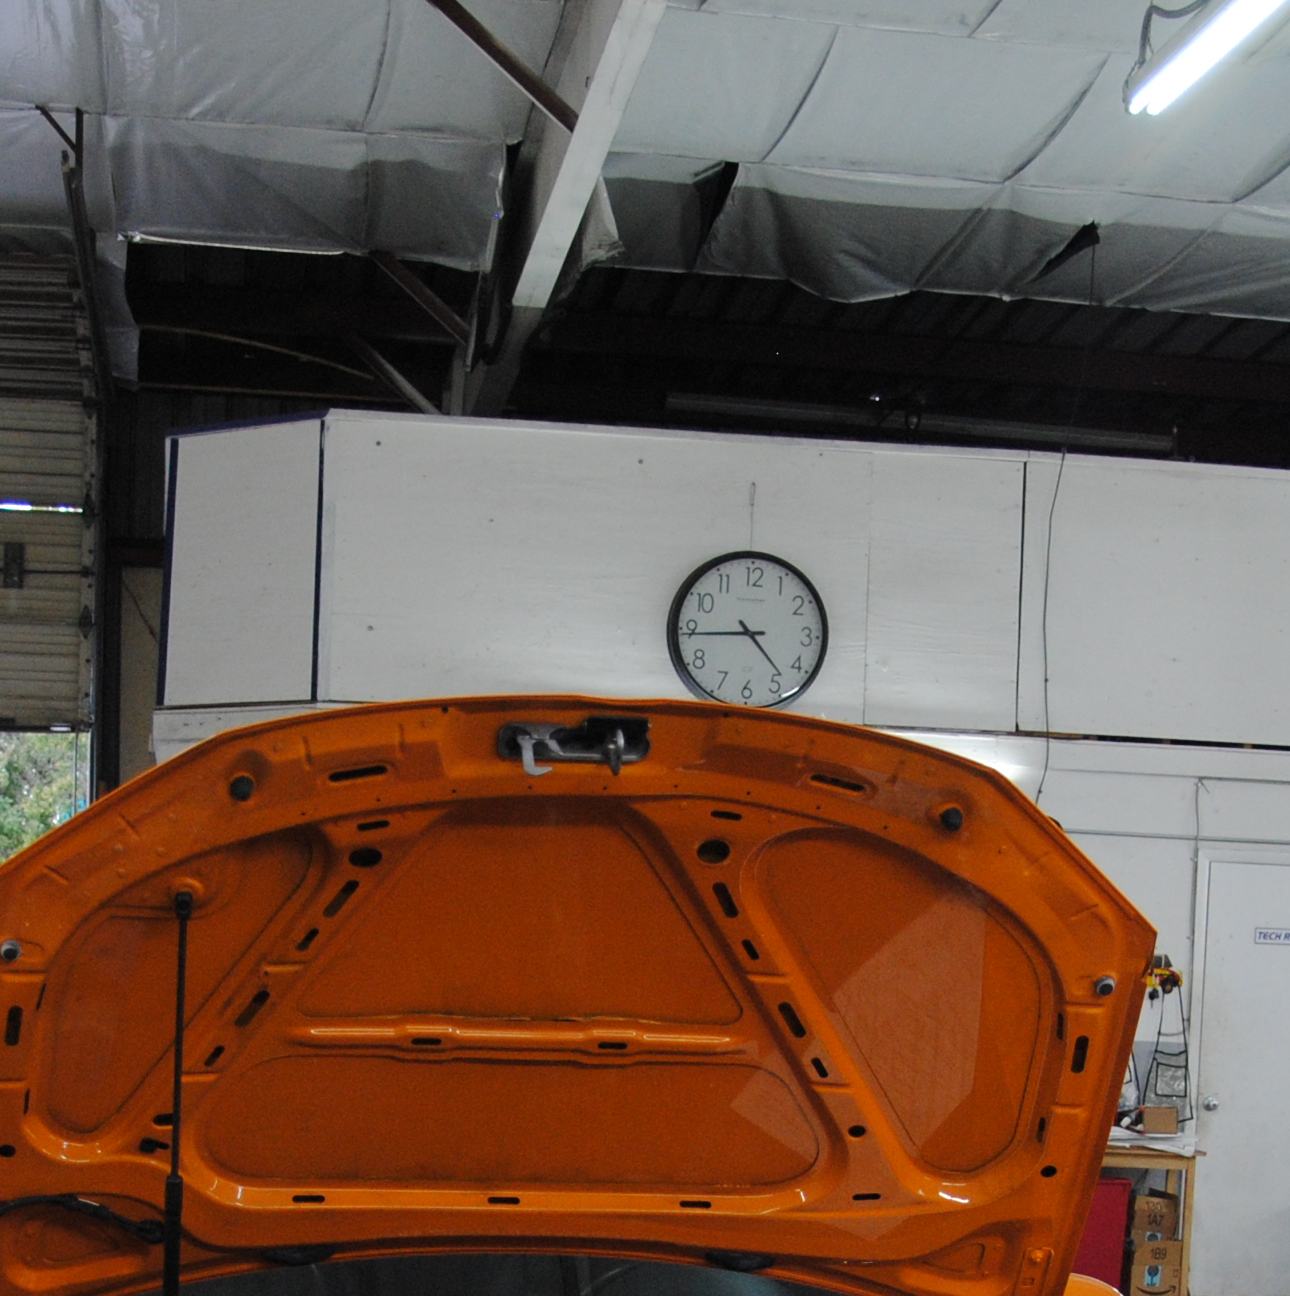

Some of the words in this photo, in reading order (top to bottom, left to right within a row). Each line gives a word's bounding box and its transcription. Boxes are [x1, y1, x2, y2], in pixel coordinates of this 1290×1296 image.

[718, 574, 731, 594] 11
[746, 566, 764, 588] 12
[777, 575, 784, 596] 1
[696, 592, 715, 614] 10
[792, 595, 805, 616] 2
[685, 619, 698, 639] 9
[800, 626, 813, 647] 3
[692, 648, 706, 670] 8
[790, 655, 802, 674] 4
[717, 670, 730, 691] 7
[740, 679, 753, 700] 6
[768, 673, 782, 694] 5
[1258, 931, 1282, 940] TECH
[1150, 1247, 1167, 1260] 1B9
